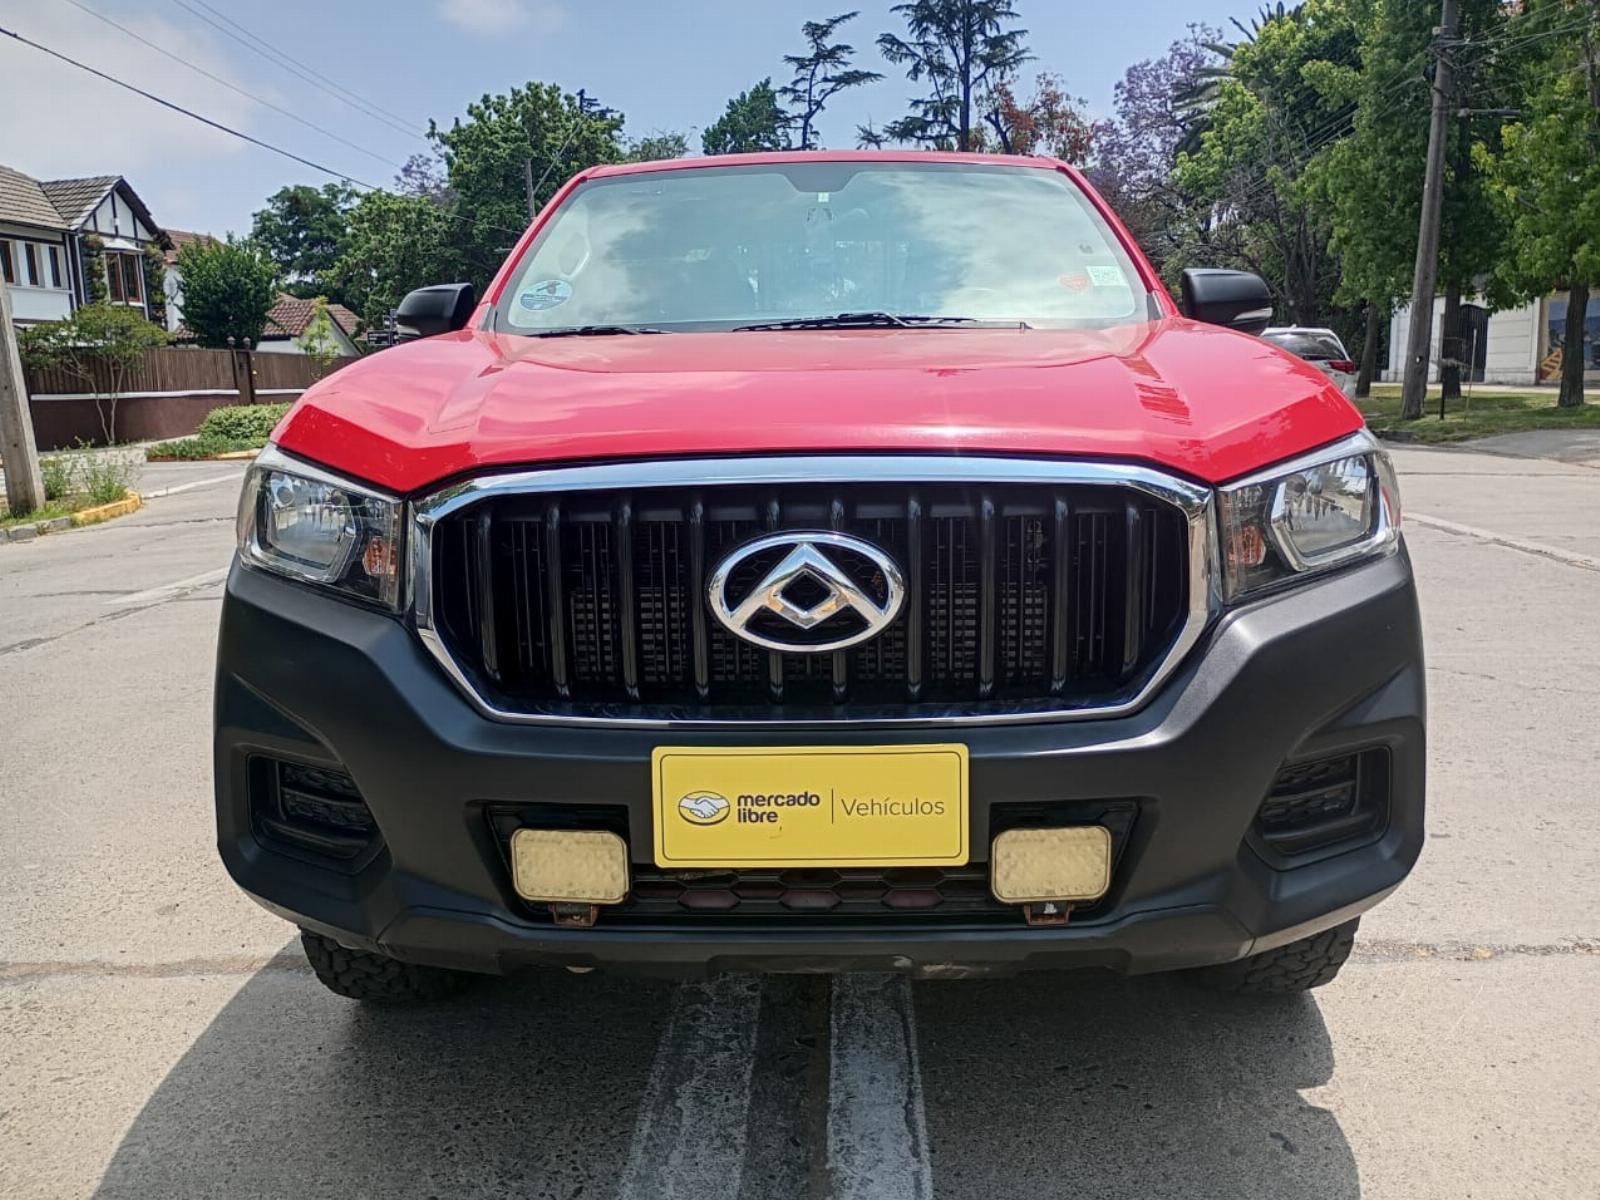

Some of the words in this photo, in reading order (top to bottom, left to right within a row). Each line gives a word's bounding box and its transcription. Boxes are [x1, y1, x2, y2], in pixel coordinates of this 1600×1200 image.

[737, 791, 820, 807] mercado
[841, 797, 945, 817] Vehículos
[737, 808, 779, 823] libre
